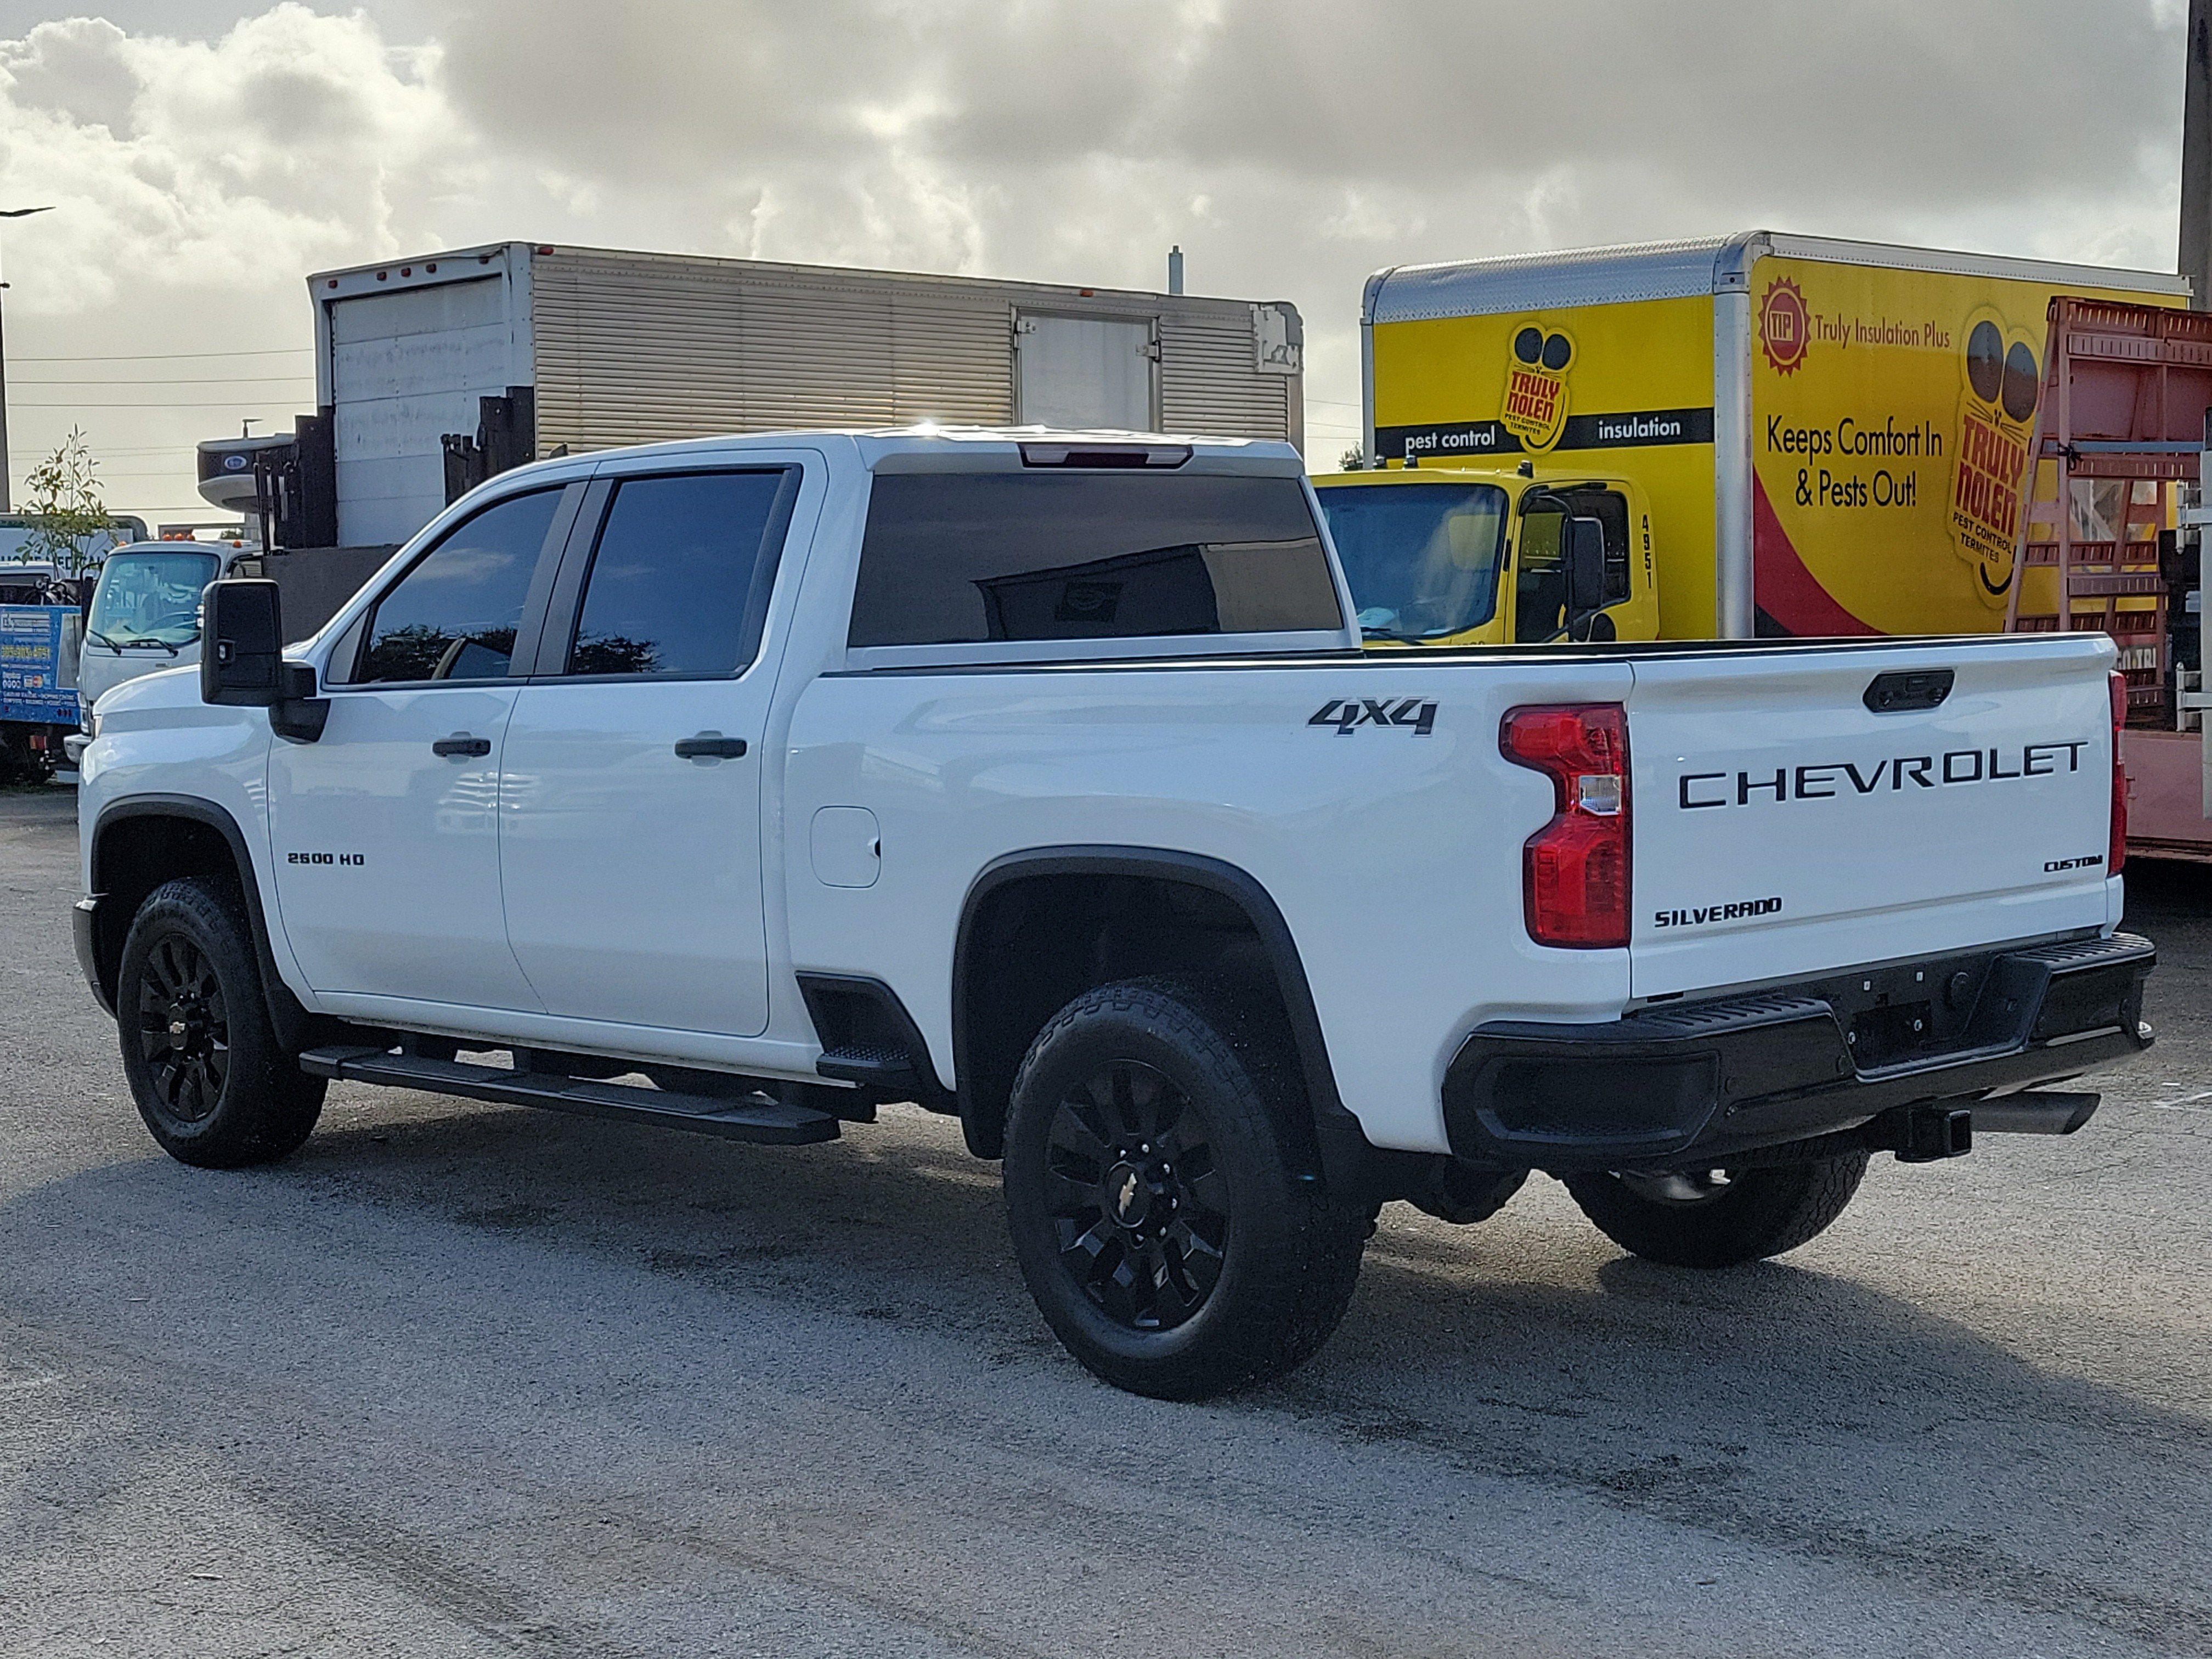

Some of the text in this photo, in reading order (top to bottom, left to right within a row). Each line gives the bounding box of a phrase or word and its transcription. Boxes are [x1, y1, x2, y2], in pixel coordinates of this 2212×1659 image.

[1771, 313, 1791, 338] TIP
[1815, 313, 1951, 349] Truly Insulation Plus
[1511, 371, 1560, 400] TRULY
[1506, 391, 1555, 424] NOLEN
[1405, 425, 1496, 455] pest control
[1599, 416, 1681, 439] insulation
[1768, 414, 1942, 466] Keeps Comfort In
[1962, 414, 2026, 489] TRULY
[1796, 469, 1916, 507] & Pests Out!
[1955, 461, 2018, 538] NOLEN
[1953, 511, 2012, 554] PEST CONTROL
[1961, 532, 2000, 563] TERMITES
[1642, 514, 1652, 589] 4951
[1679, 742, 2089, 809] CHEVROLET
[287, 853, 364, 865] 2500 HD
[2044, 855, 2103, 872] CUSTOM
[1655, 897, 1782, 928] SILVERADO
